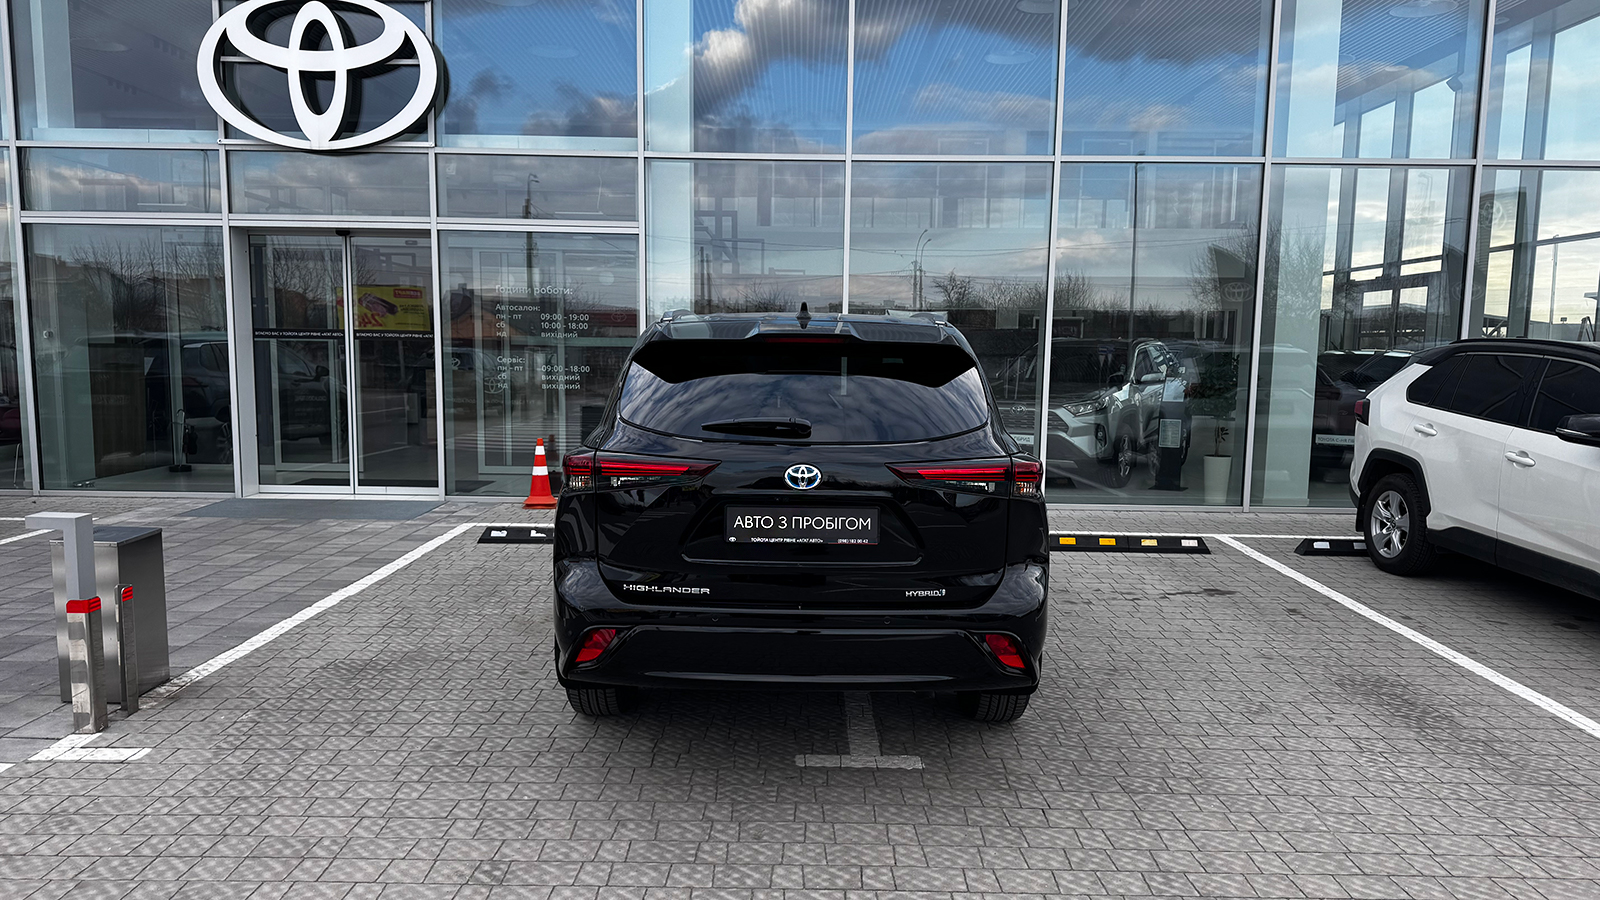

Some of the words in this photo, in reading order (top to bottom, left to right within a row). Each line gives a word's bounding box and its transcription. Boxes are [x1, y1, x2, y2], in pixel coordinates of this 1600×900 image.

[495, 285, 531, 294] Години
[533, 285, 573, 295] роботи:
[495, 303, 540, 311] Автосалон:
[540, 313, 562, 321] 09:00
[568, 322, 589, 330] 18:00
[496, 356, 525, 364] Сервіс:
[570, 365, 590, 373] 18:00
[497, 372, 507, 380] сб
[541, 373, 580, 381] вихідний
[541, 382, 580, 390] вихідний
[733, 515, 774, 529] АВТО
[778, 516, 788, 529] З
[792, 516, 871, 530] ПРОБІГОМ
[623, 583, 711, 595] HIGHLANDER
